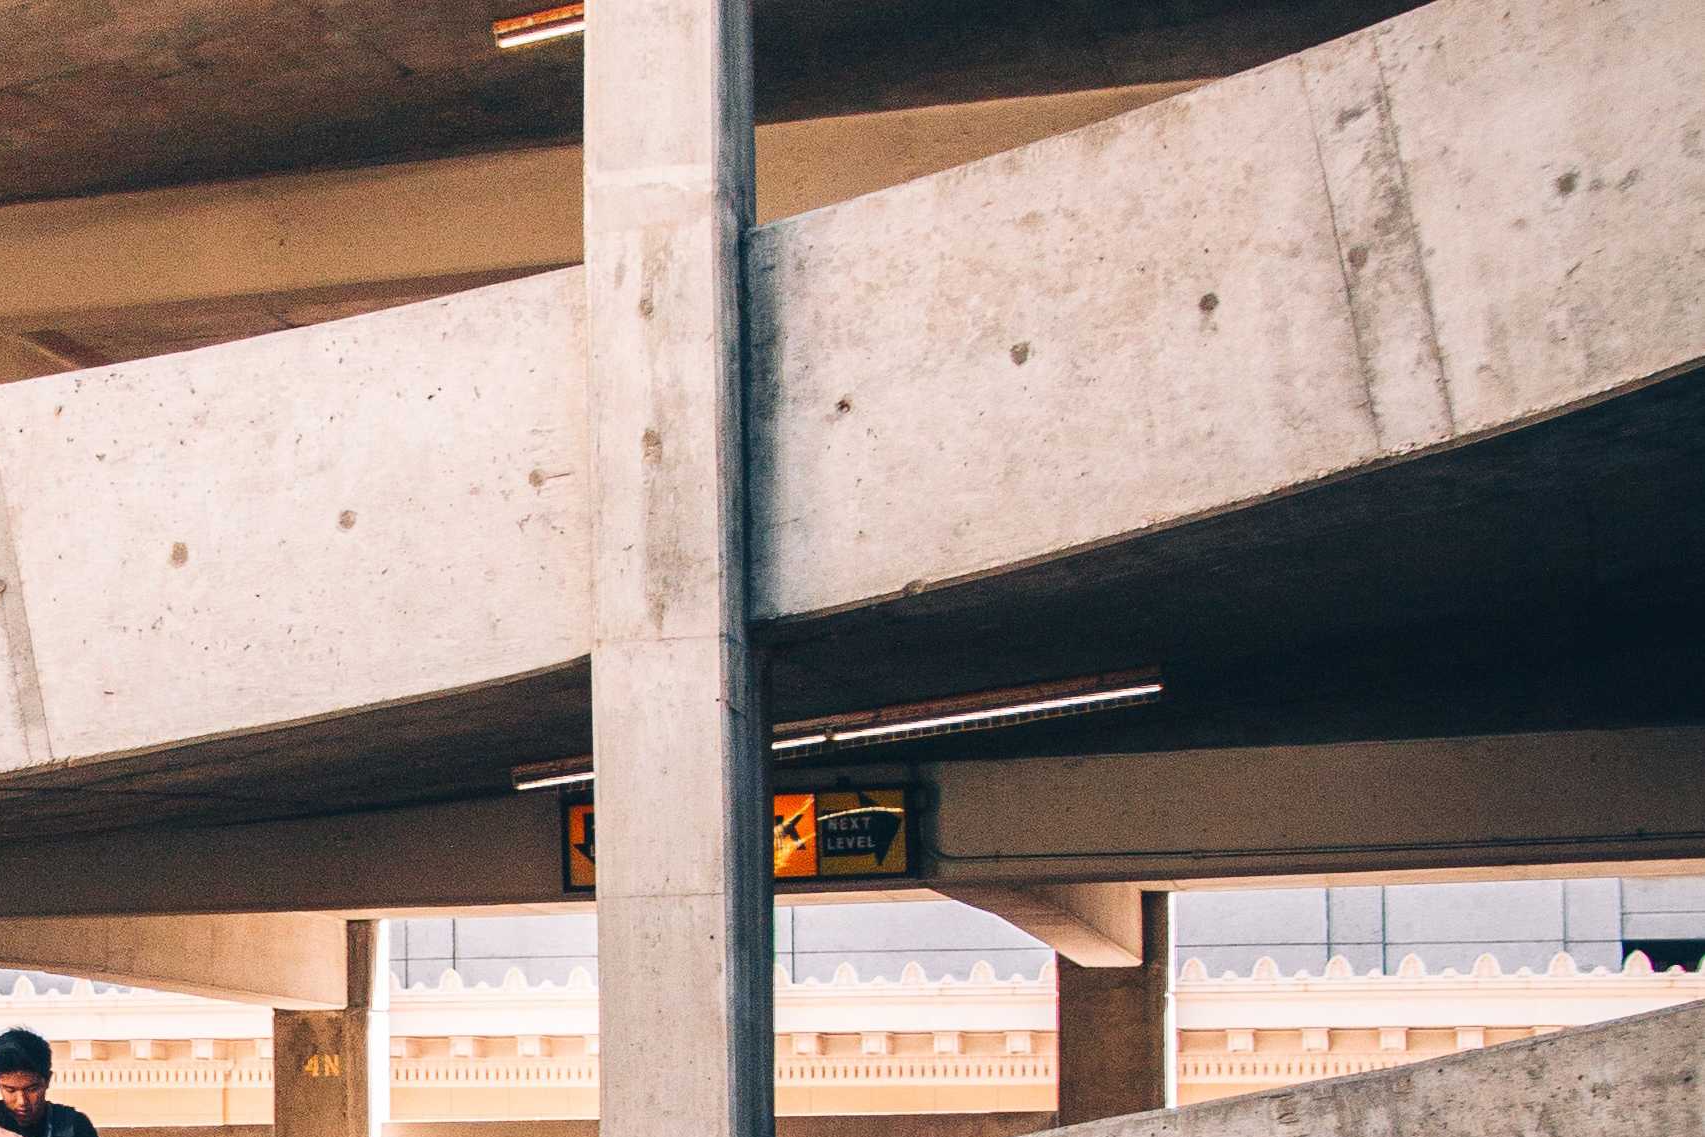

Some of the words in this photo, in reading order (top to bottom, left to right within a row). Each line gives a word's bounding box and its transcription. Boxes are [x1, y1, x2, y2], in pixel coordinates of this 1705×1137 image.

[827, 816, 871, 831] NEXT
[826, 835, 876, 851] LEVEL
[305, 1054, 341, 1077] 4N
